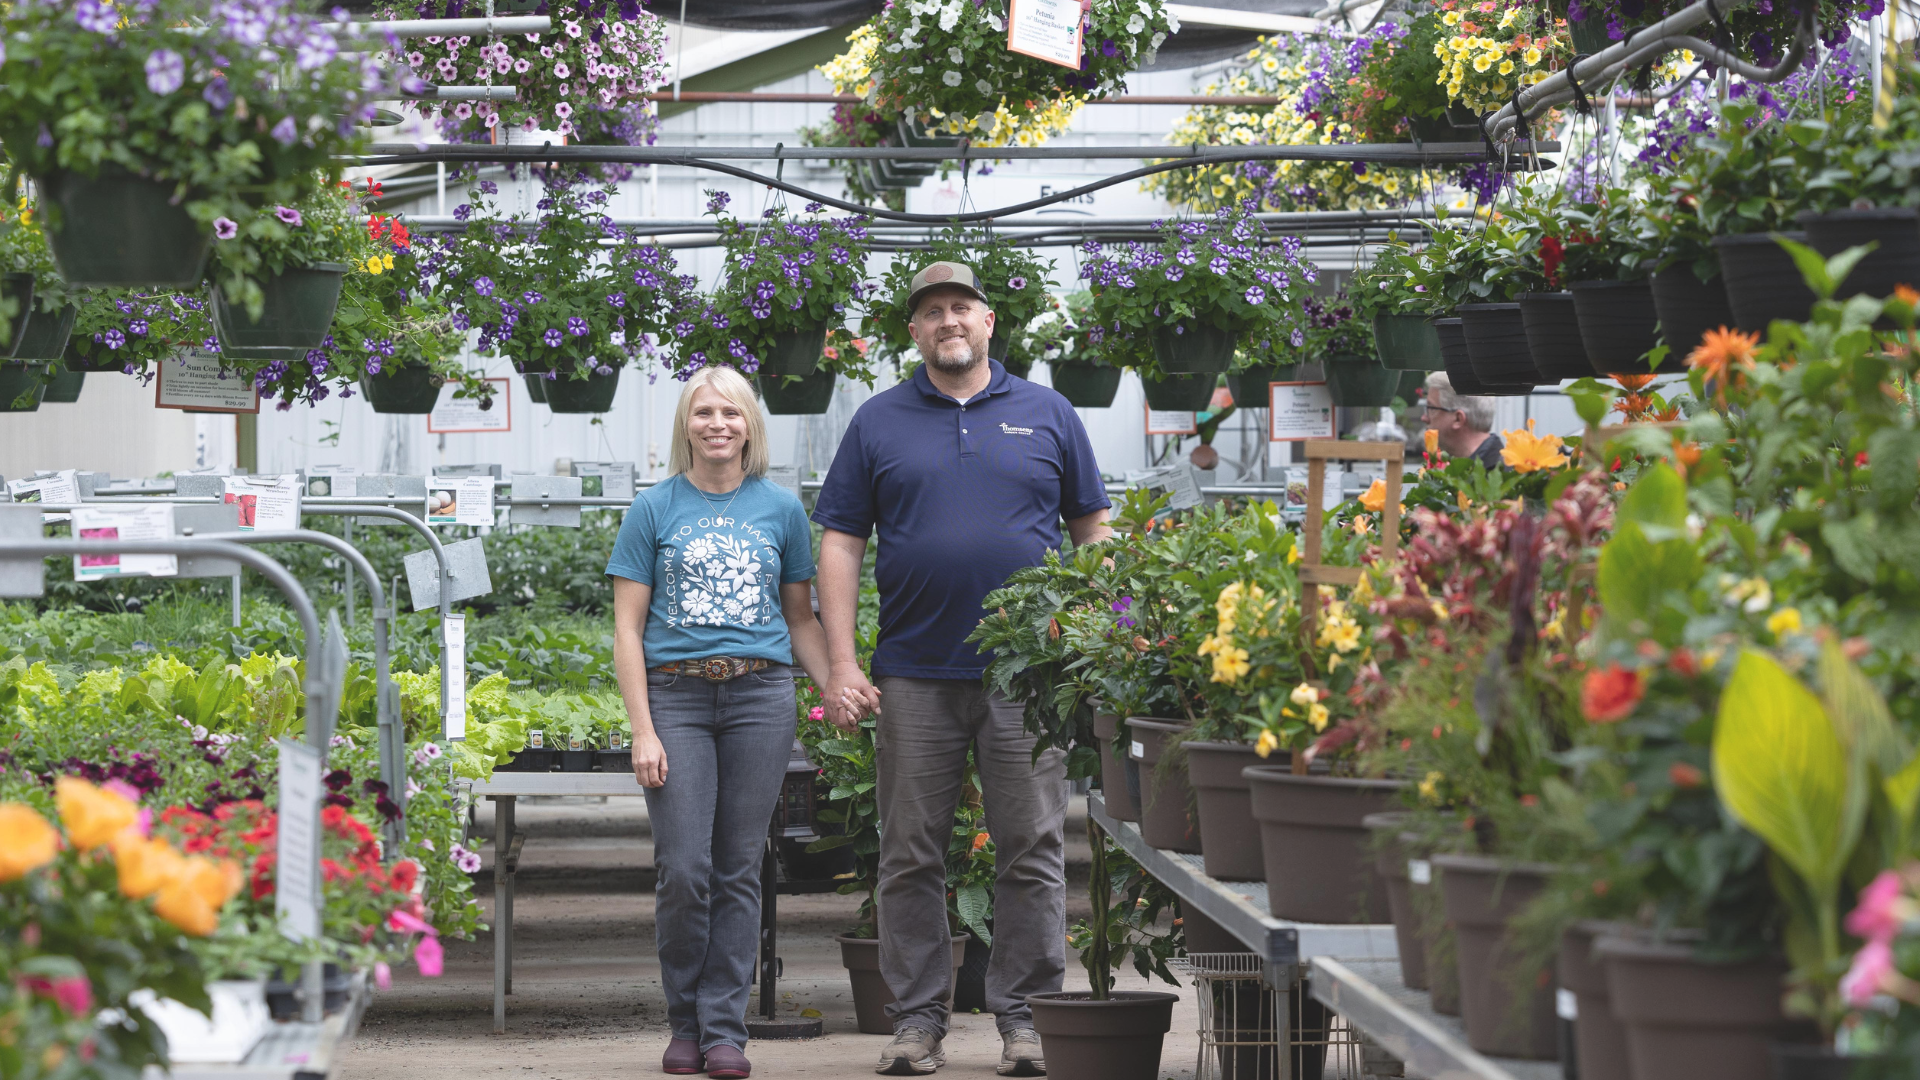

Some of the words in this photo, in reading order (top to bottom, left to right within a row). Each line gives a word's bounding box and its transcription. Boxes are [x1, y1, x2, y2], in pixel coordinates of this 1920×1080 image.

[1036, 9, 1055, 20] Petunia
[1033, 16, 1051, 27] Hanging
[1041, 185, 1095, 204] Fits
[189, 372, 216, 380] Hanging
[999, 422, 1033, 433] Thomsens
[664, 547, 677, 628] WELCOME
[671, 525, 692, 542] TO
[697, 517, 735, 529] OUR
[741, 521, 775, 567] HAPPY
[762, 573, 773, 626] PLACE
